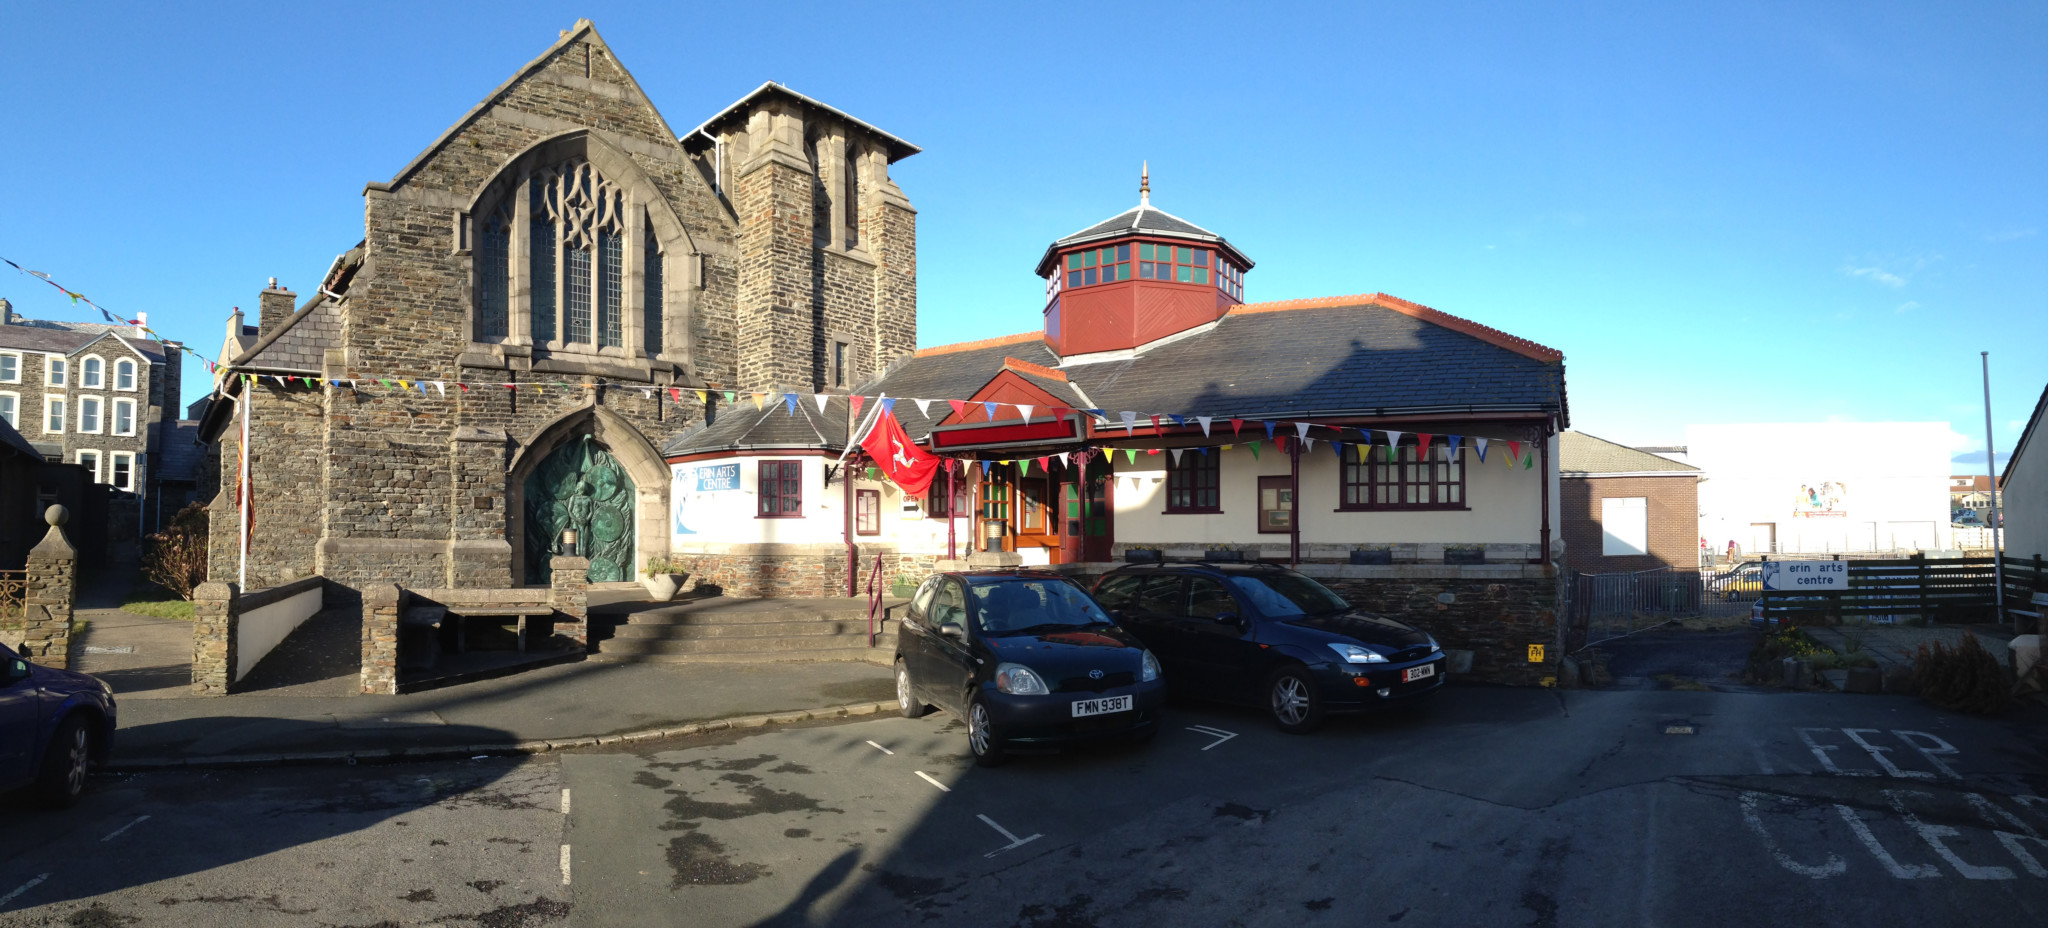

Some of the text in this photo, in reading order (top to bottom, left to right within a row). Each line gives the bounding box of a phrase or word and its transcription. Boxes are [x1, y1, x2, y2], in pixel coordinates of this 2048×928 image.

[700, 465, 736, 480] ERIN ARTS
[703, 477, 731, 490] CENTRE
[903, 495, 919, 503] OPEN
[1789, 562, 1843, 573] erin arts
[1797, 576, 1834, 585] centre
[1076, 697, 1128, 715] FMN 938T
